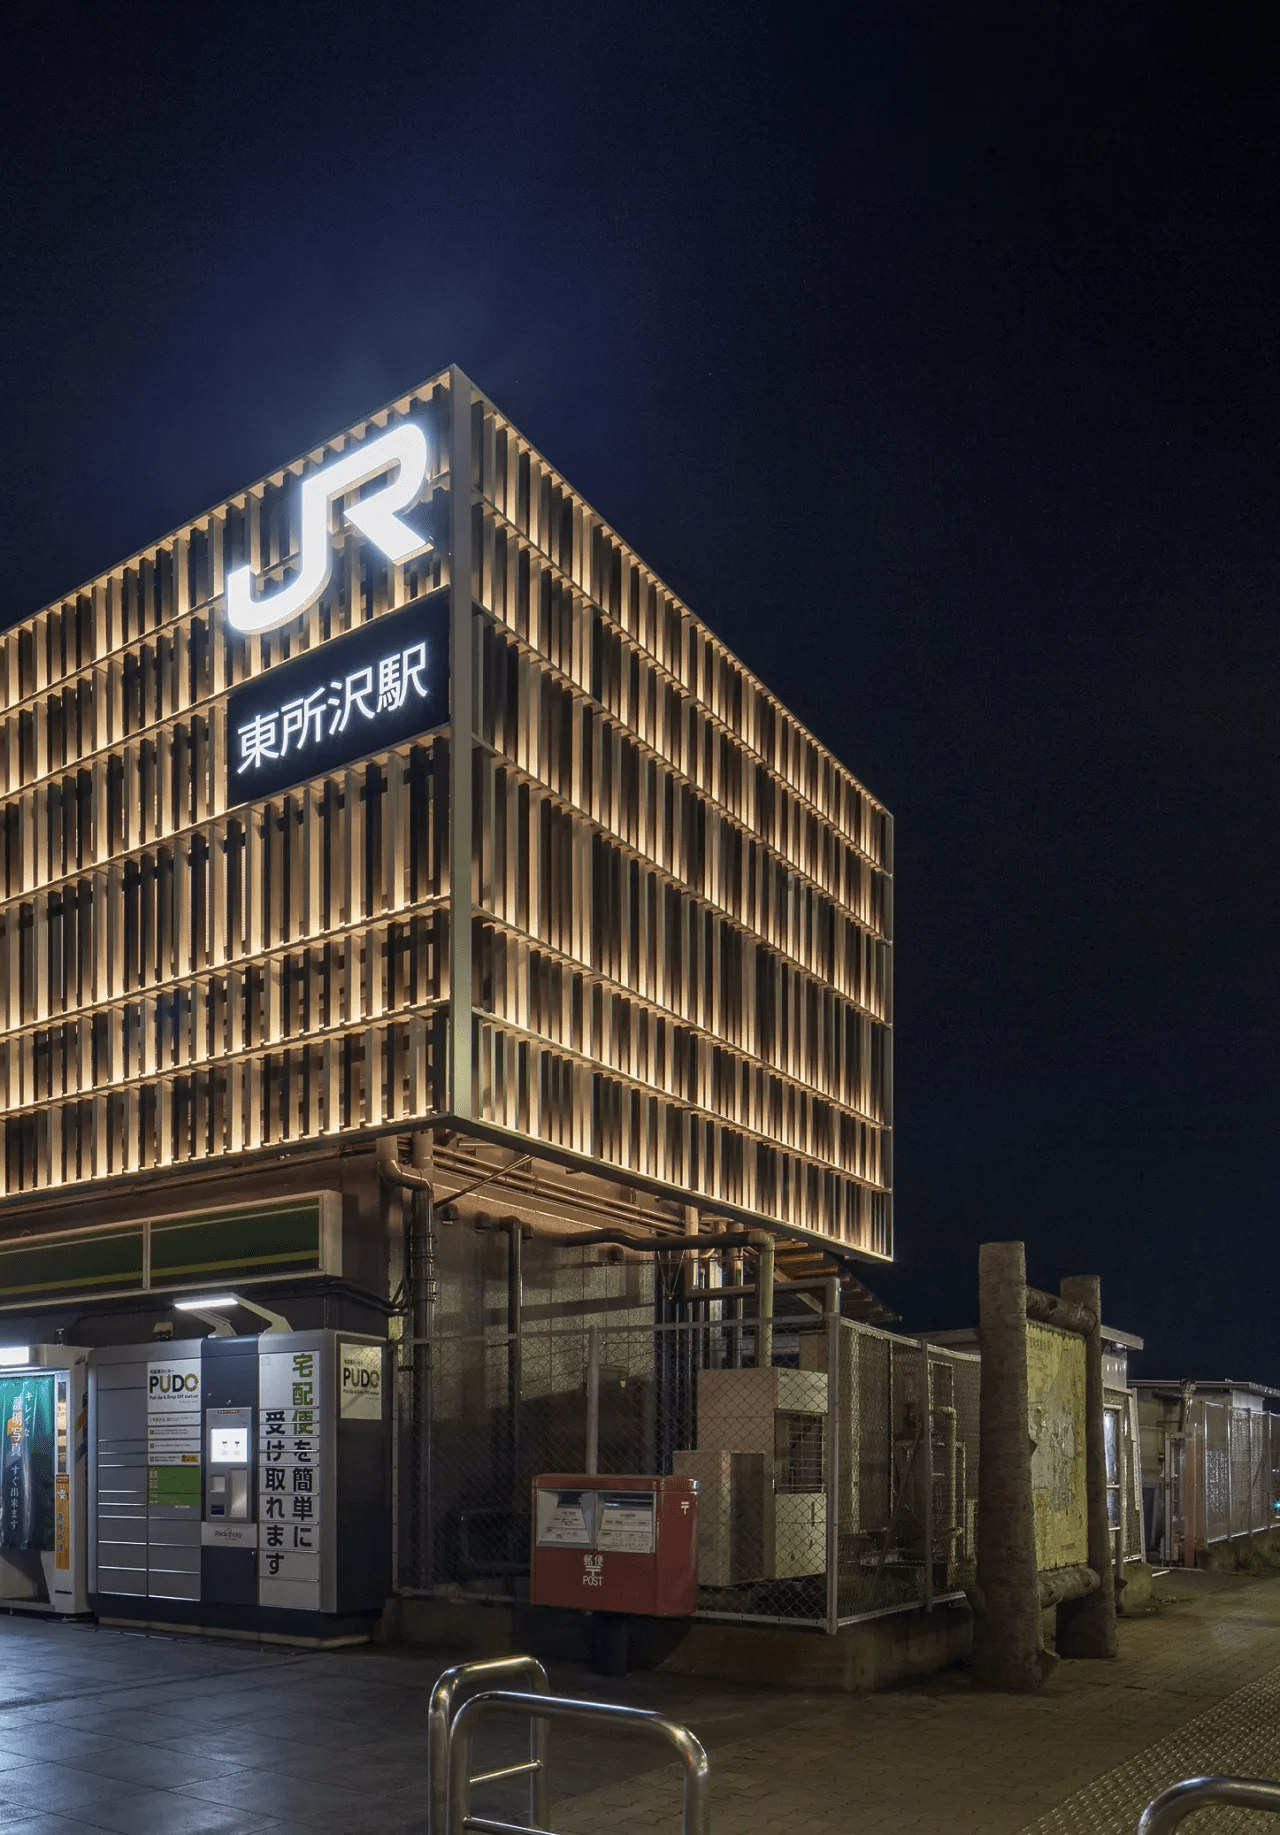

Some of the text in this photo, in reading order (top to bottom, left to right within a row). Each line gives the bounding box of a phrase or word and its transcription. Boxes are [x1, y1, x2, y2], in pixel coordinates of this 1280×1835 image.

[227, 423, 431, 634] JR
[237, 642, 429, 774] 東所沢駅
[149, 1373, 199, 1394] PUDO
[343, 1367, 380, 1389] PUDO
[292, 1353, 314, 1548] 宅配便を簡単に
[265, 1410, 286, 1575] 受け取れます
[582, 1576, 604, 1586] POST
[583, 1554, 604, 1567] 郵便
